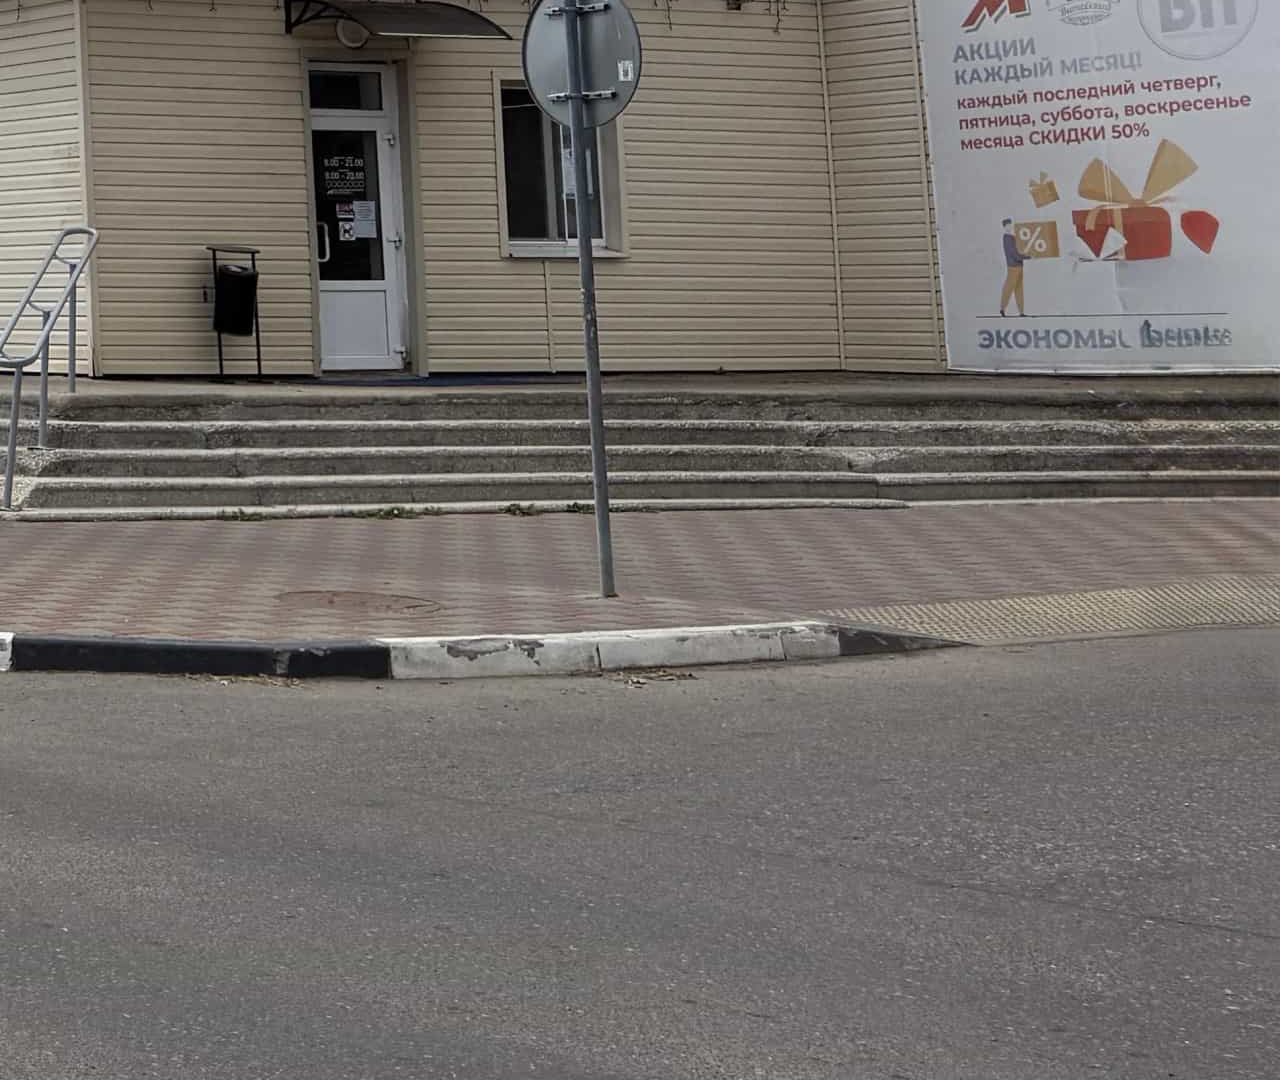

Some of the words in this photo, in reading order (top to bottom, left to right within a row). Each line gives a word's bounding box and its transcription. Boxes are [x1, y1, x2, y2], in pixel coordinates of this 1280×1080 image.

[952, 36, 1036, 63] АКЦИИ
[955, 56, 1053, 85] КАЖДЫЙ
[957, 90, 1028, 110] каждый
[1033, 80, 1135, 104] последний
[1140, 75, 1221, 93] четверг,
[959, 113, 1036, 130] пятница,
[1040, 105, 1119, 126] суббота,
[1124, 95, 1251, 117] воскресенье
[960, 134, 1024, 150] месяца
[1029, 125, 1106, 145] СКИДКИ
[1111, 122, 1150, 140] 50%
[1019, 227, 1047, 253] %
